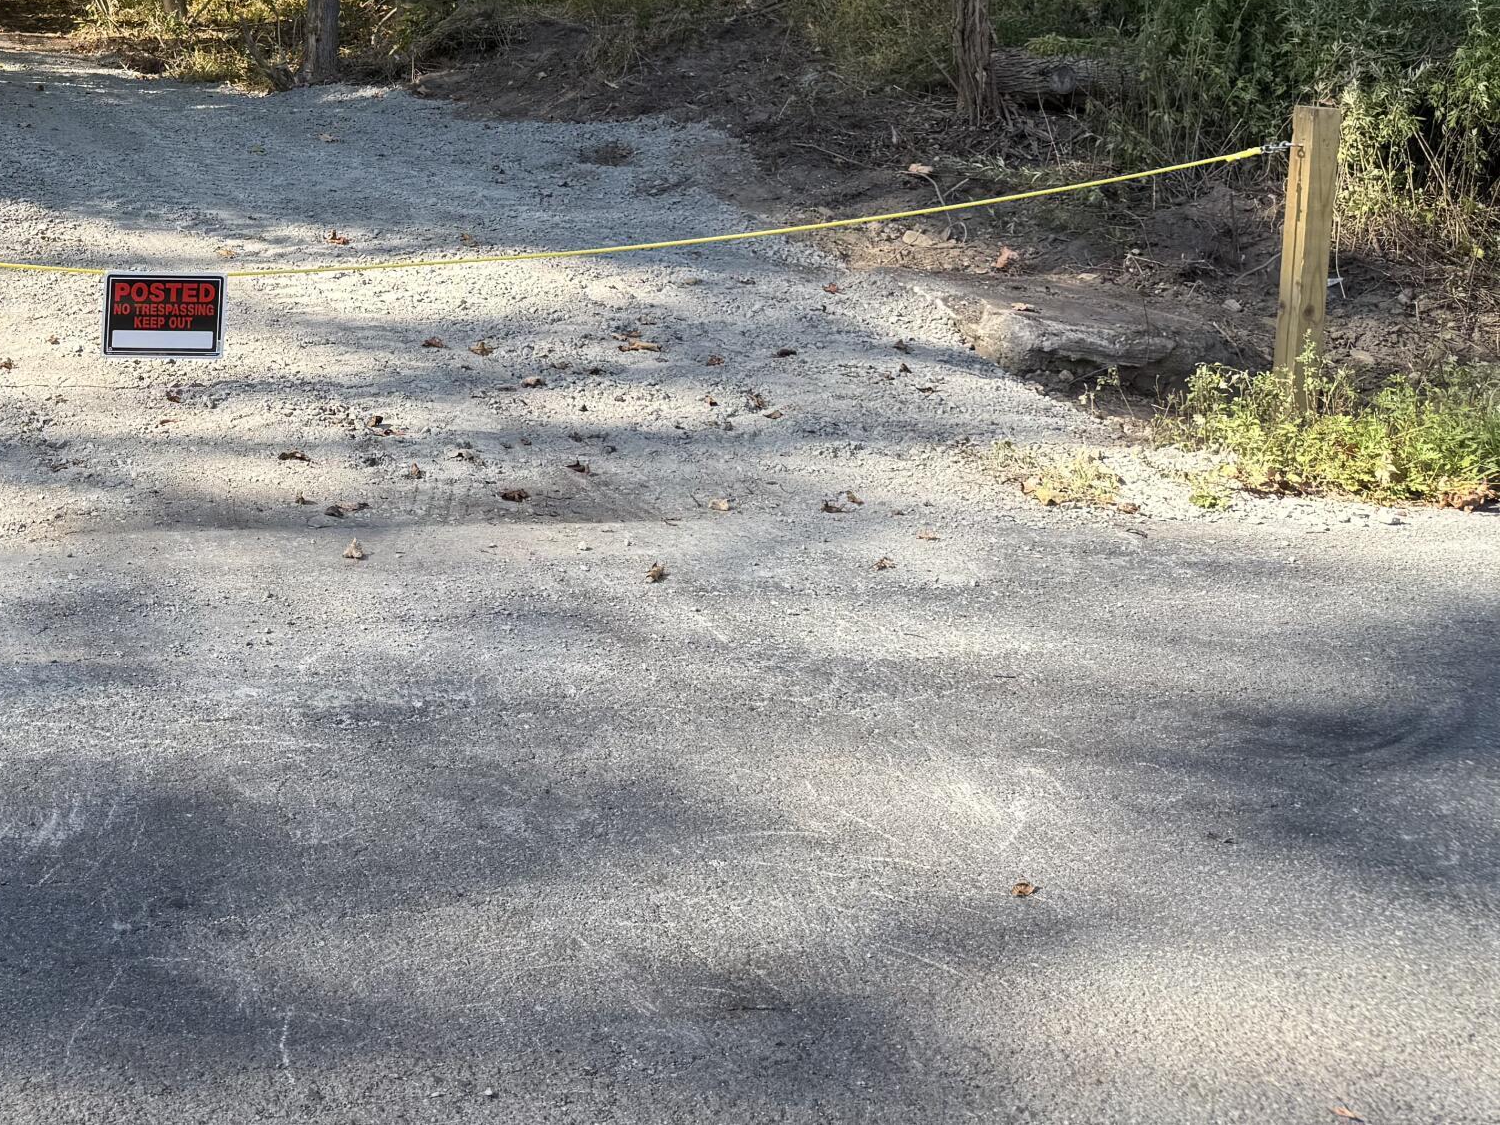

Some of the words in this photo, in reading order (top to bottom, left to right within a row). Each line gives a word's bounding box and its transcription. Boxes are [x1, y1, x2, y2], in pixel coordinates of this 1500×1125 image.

[114, 282, 216, 303] POSTED
[114, 303, 131, 315] NO
[135, 304, 214, 316] TRESPASSING
[134, 316, 165, 328] KEEP
[169, 317, 193, 329] OUT
